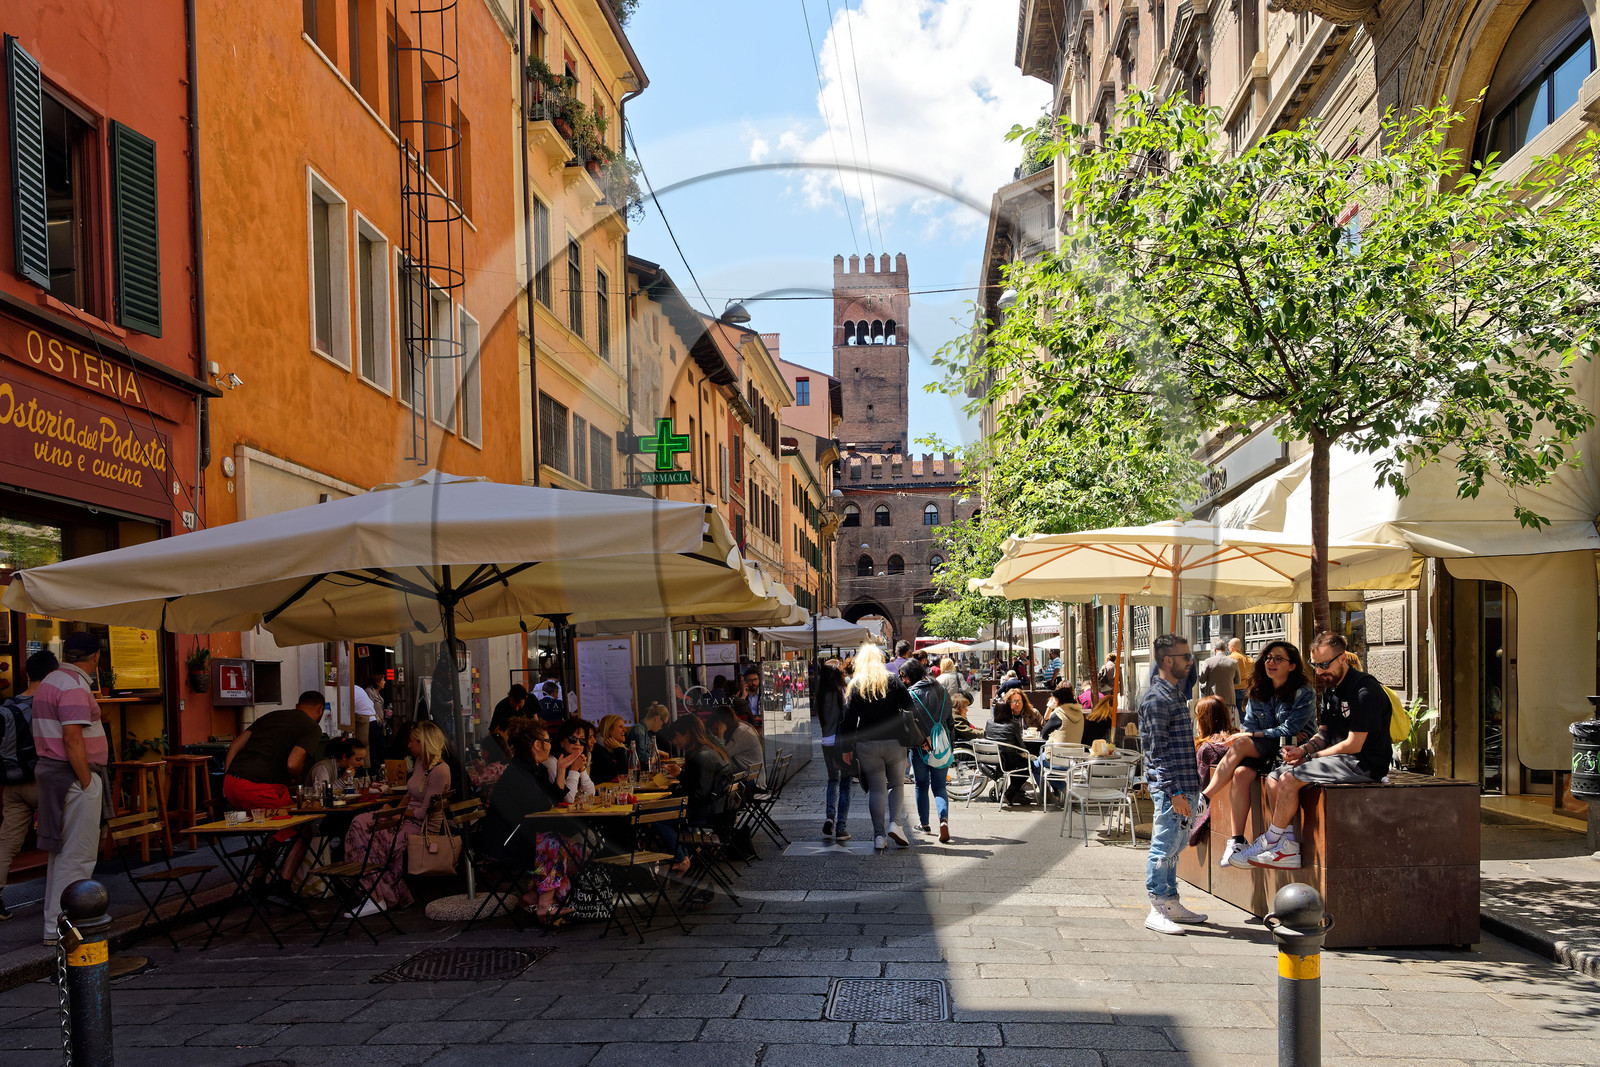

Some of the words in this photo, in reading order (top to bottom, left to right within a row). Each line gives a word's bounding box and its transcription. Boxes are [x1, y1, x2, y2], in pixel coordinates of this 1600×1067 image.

[27, 330, 141, 404] OSTERIA
[0, 382, 76, 444] Osteria
[77, 425, 98, 451] del
[34, 441, 73, 468] vino
[77, 455, 86, 471] e
[92, 458, 143, 488] cucina
[641, 473, 689, 483] FARMACIA
[687, 697, 735, 706] EATALY
